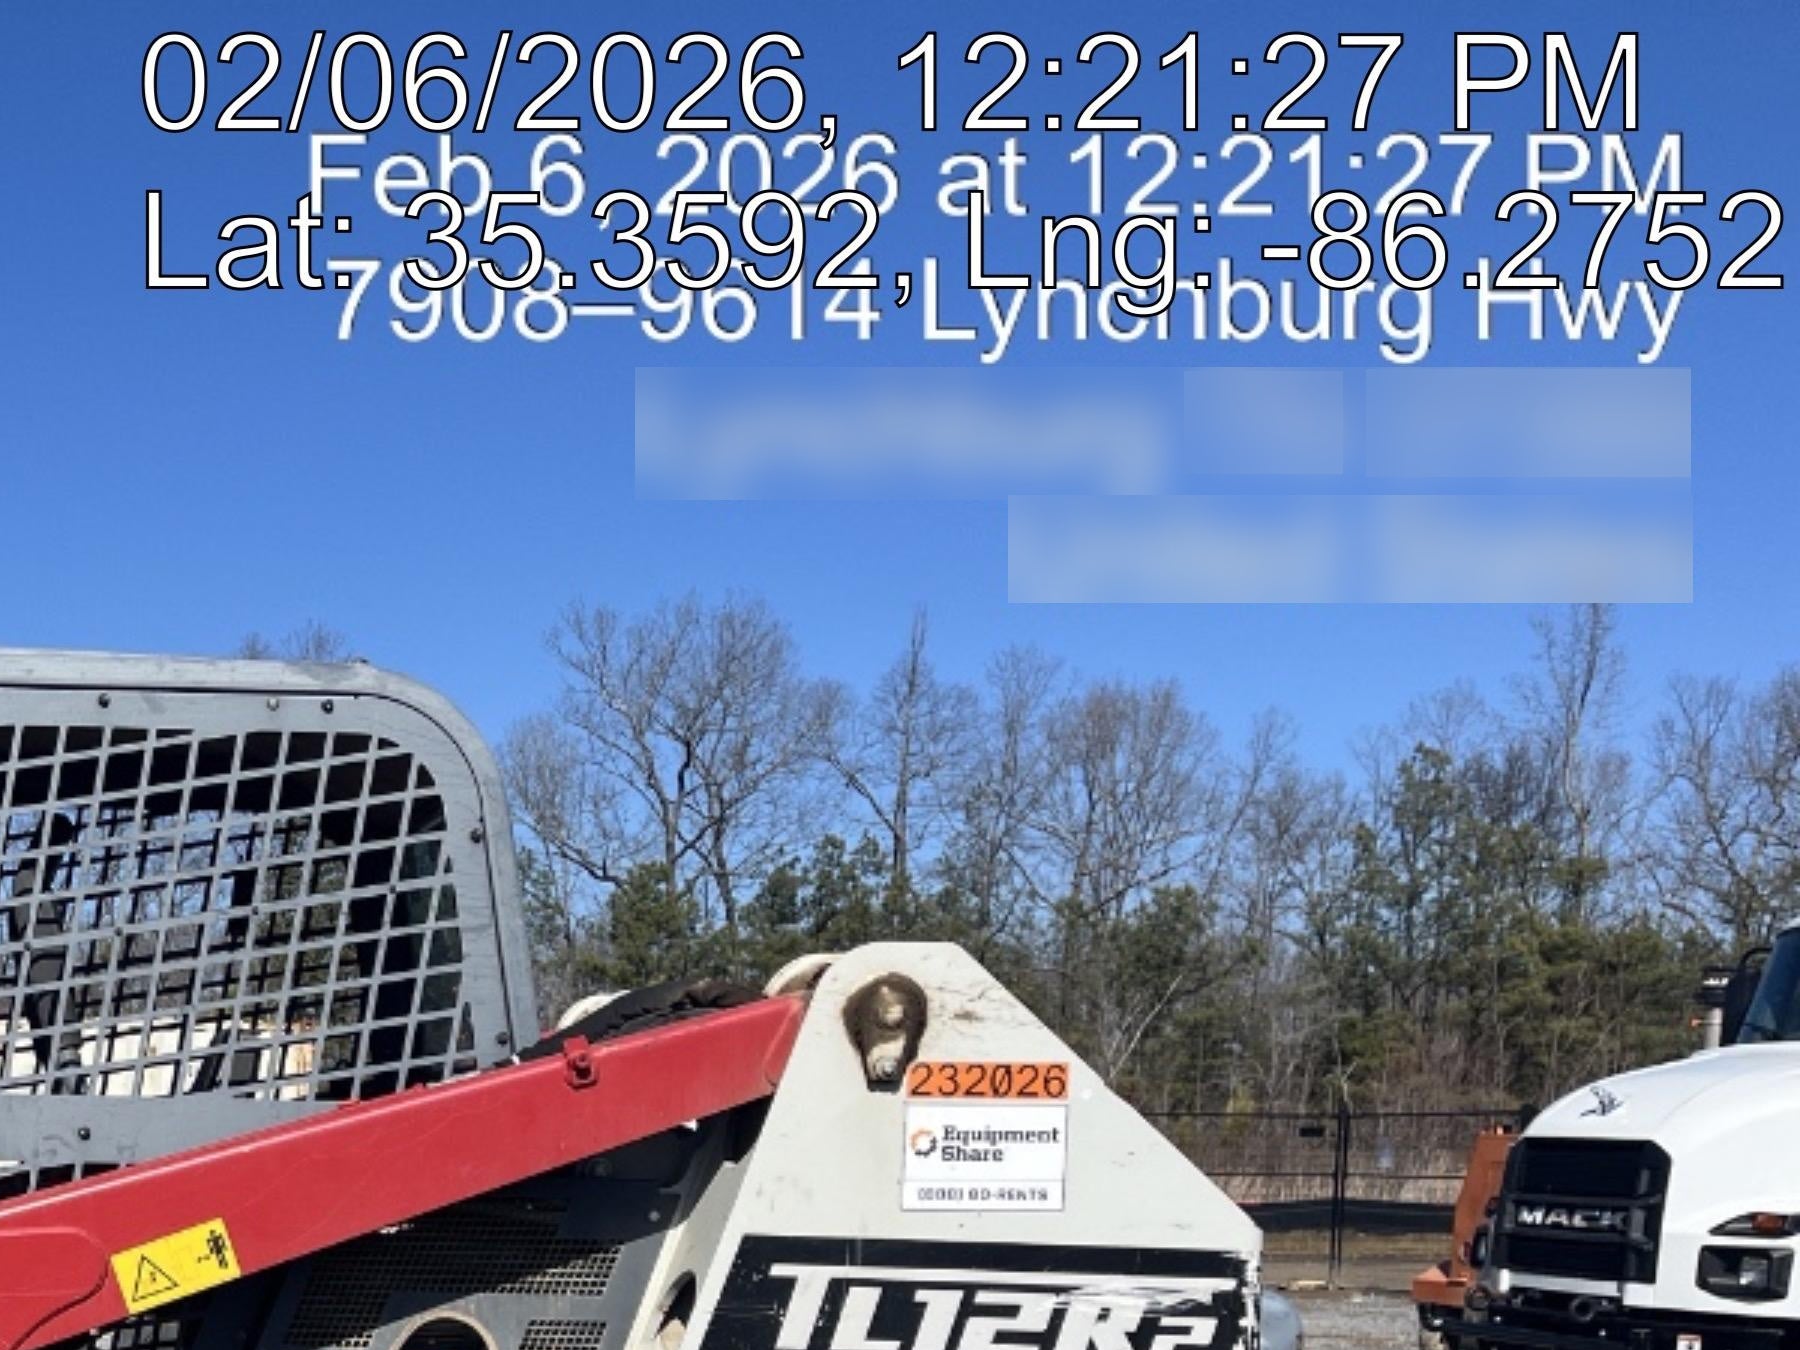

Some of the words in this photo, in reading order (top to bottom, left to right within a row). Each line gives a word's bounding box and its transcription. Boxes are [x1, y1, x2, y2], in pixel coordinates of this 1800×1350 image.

[909, 1064, 1067, 1098] 232026
[941, 1125, 1060, 1146] Equipment
[941, 1145, 1004, 1162] Share
[1516, 1204, 1627, 1230] MACK
